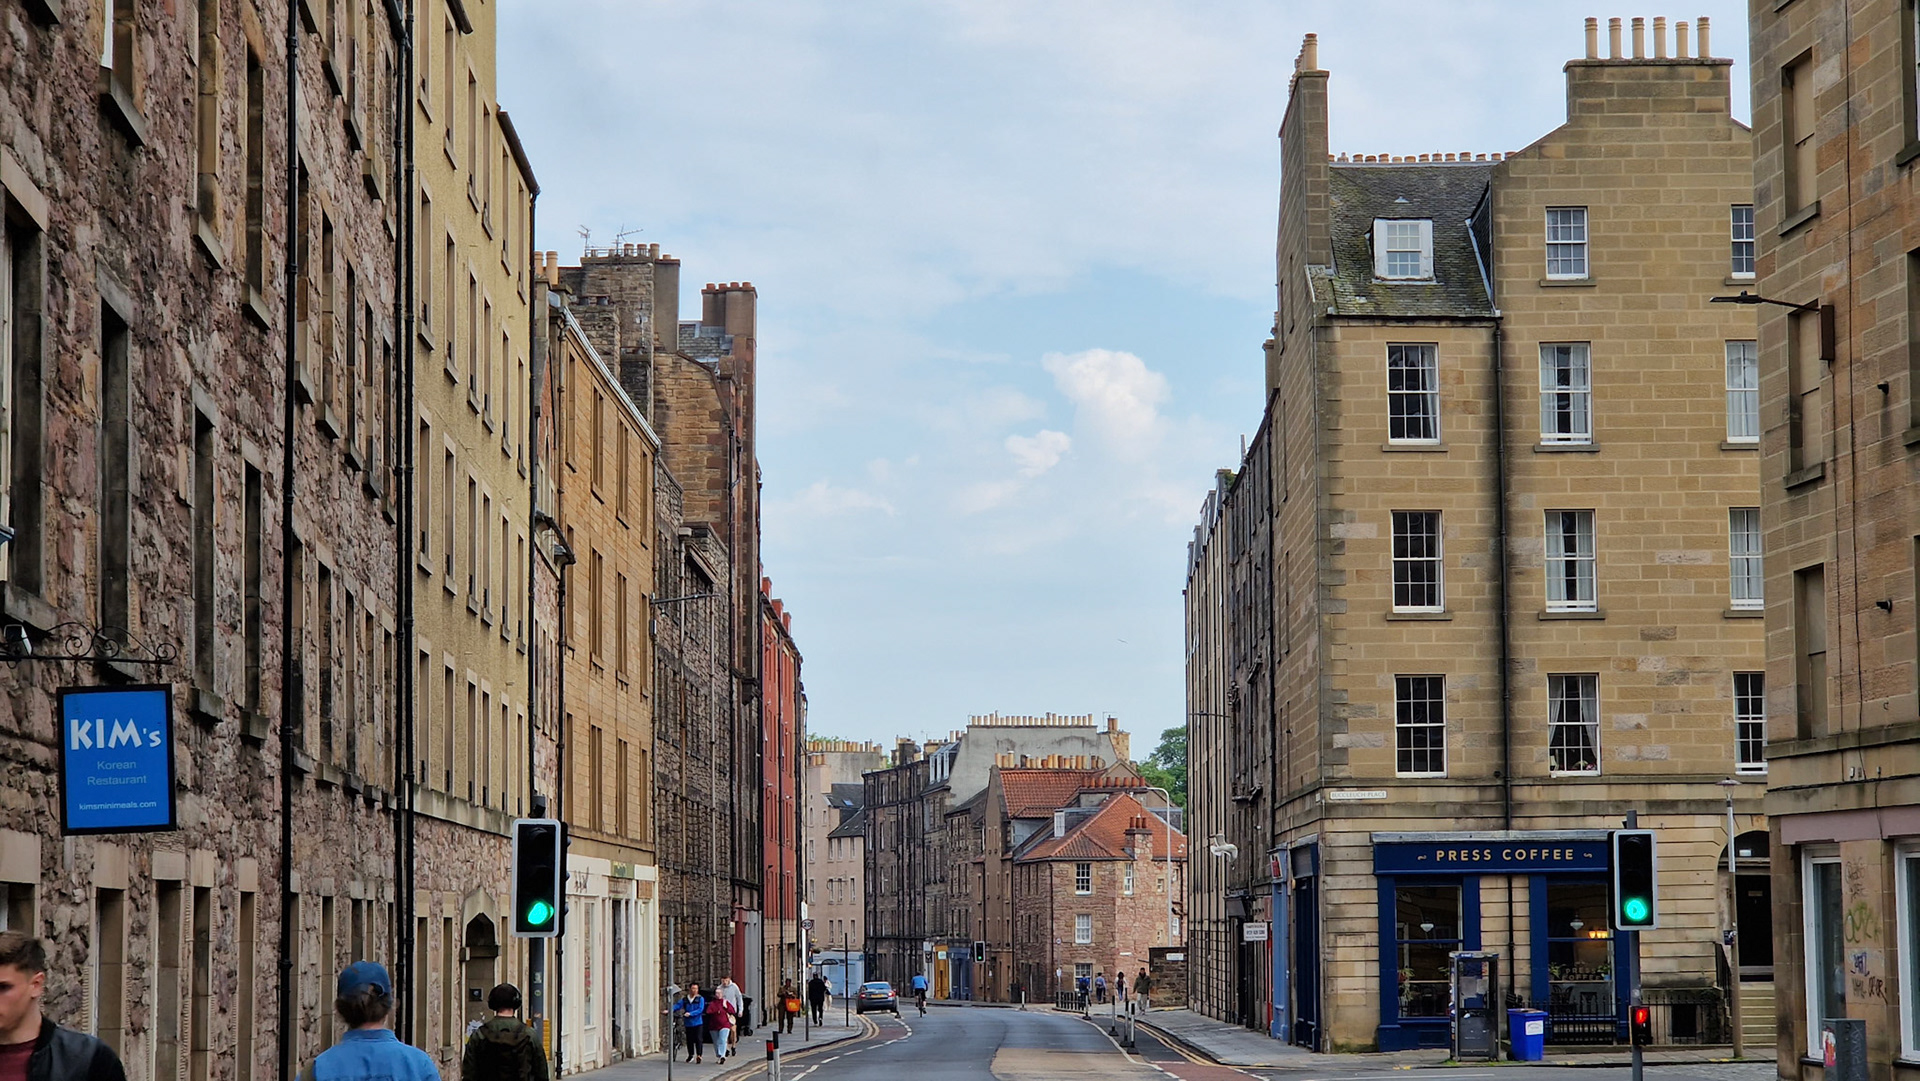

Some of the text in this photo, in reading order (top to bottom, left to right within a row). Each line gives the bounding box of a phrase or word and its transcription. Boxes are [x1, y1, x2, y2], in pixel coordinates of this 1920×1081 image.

[70, 718, 162, 750] KIM's
[97, 761, 136, 770] Korean
[87, 776, 147, 786] Restaurant
[79, 801, 157, 810] kimsminimeals.com
[1436, 848, 1574, 861] PRESS COFFEE
